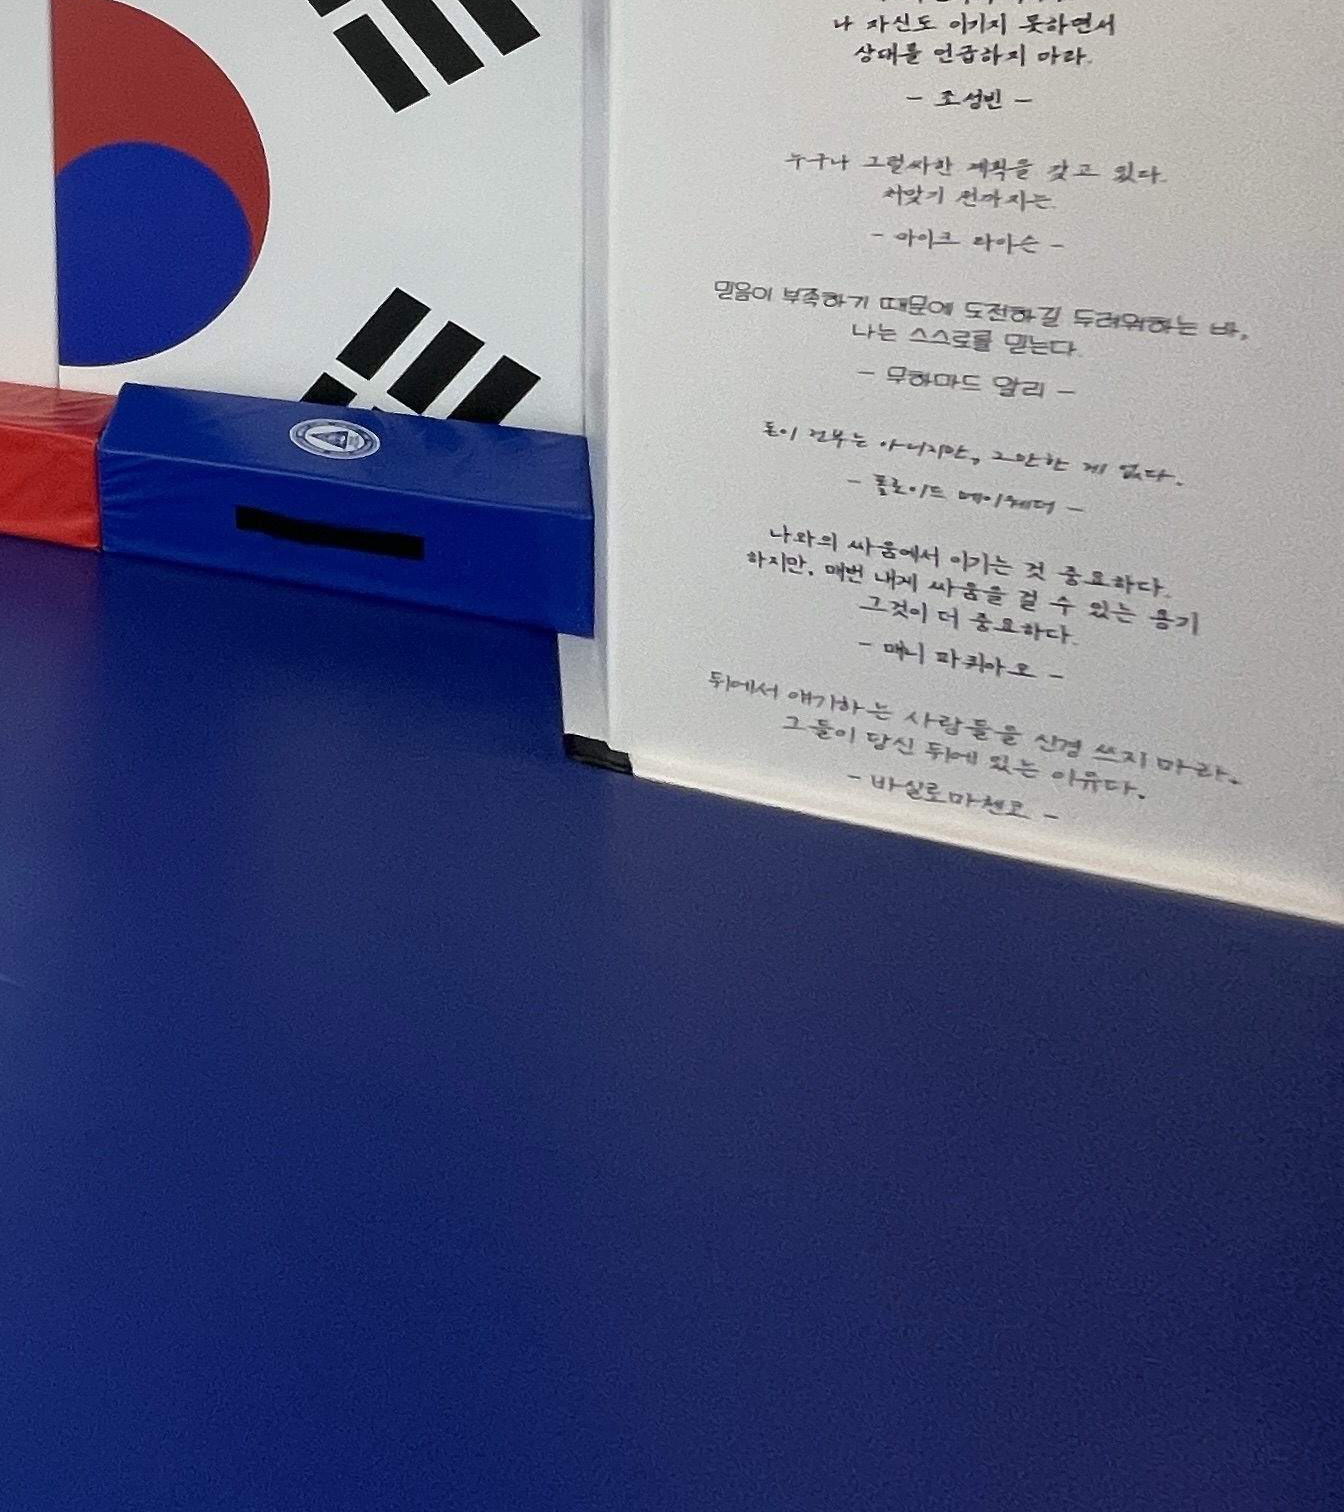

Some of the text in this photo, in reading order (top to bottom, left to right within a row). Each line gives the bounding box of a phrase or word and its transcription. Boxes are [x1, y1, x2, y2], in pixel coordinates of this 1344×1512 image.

[832, 11, 1116, 37] 나 자신도 이기지 못하면서
[853, 41, 923, 67] 상대를
[933, 42, 1026, 68] 언급하지
[933, 87, 1003, 111] 조성빈
[784, 152, 851, 172] 누구나
[966, 157, 1034, 182] 계획을
[1047, 158, 1101, 182] 갖고
[893, 228, 1041, 256] 마이크 타이슨
[713, 280, 773, 302] 믿음이
[782, 286, 870, 310] 부족하기
[879, 294, 955, 317] 때문에
[964, 301, 1063, 328] 도전하길
[1073, 308, 1198, 337] 두려워하는
[851, 322, 897, 343] 나는
[908, 327, 993, 353] 스스로를
[886, 365, 1046, 399] 무하마드 알리
[991, 450, 1070, 472] 그만한
[1082, 461, 1109, 476] 게
[769, 523, 838, 553] 나와의
[847, 536, 940, 569] 싸움에서
[949, 549, 1014, 577] 이기는
[824, 561, 864, 585] 매번
[874, 568, 918, 593] 내게
[927, 577, 1007, 607] 싸움을
[1018, 589, 1038, 613] 걸
[1048, 595, 1076, 617] 수
[1088, 599, 1137, 624] 있는
[1148, 608, 1199, 637] 용기
[858, 595, 928, 625] 그것이
[936, 606, 959, 630] 더
[882, 639, 925, 666] 매니
[708, 670, 779, 701] 뒤에서
[787, 688, 893, 722] 얘기하는
[904, 710, 1023, 747] 사람들을
[1034, 733, 1083, 759] 신경
[1093, 743, 1148, 769] 쓰지
[781, 715, 856, 745] 그들이
[865, 731, 914, 756] 당신
[924, 741, 979, 766] 뒤에
[989, 755, 1040, 779] 있는
